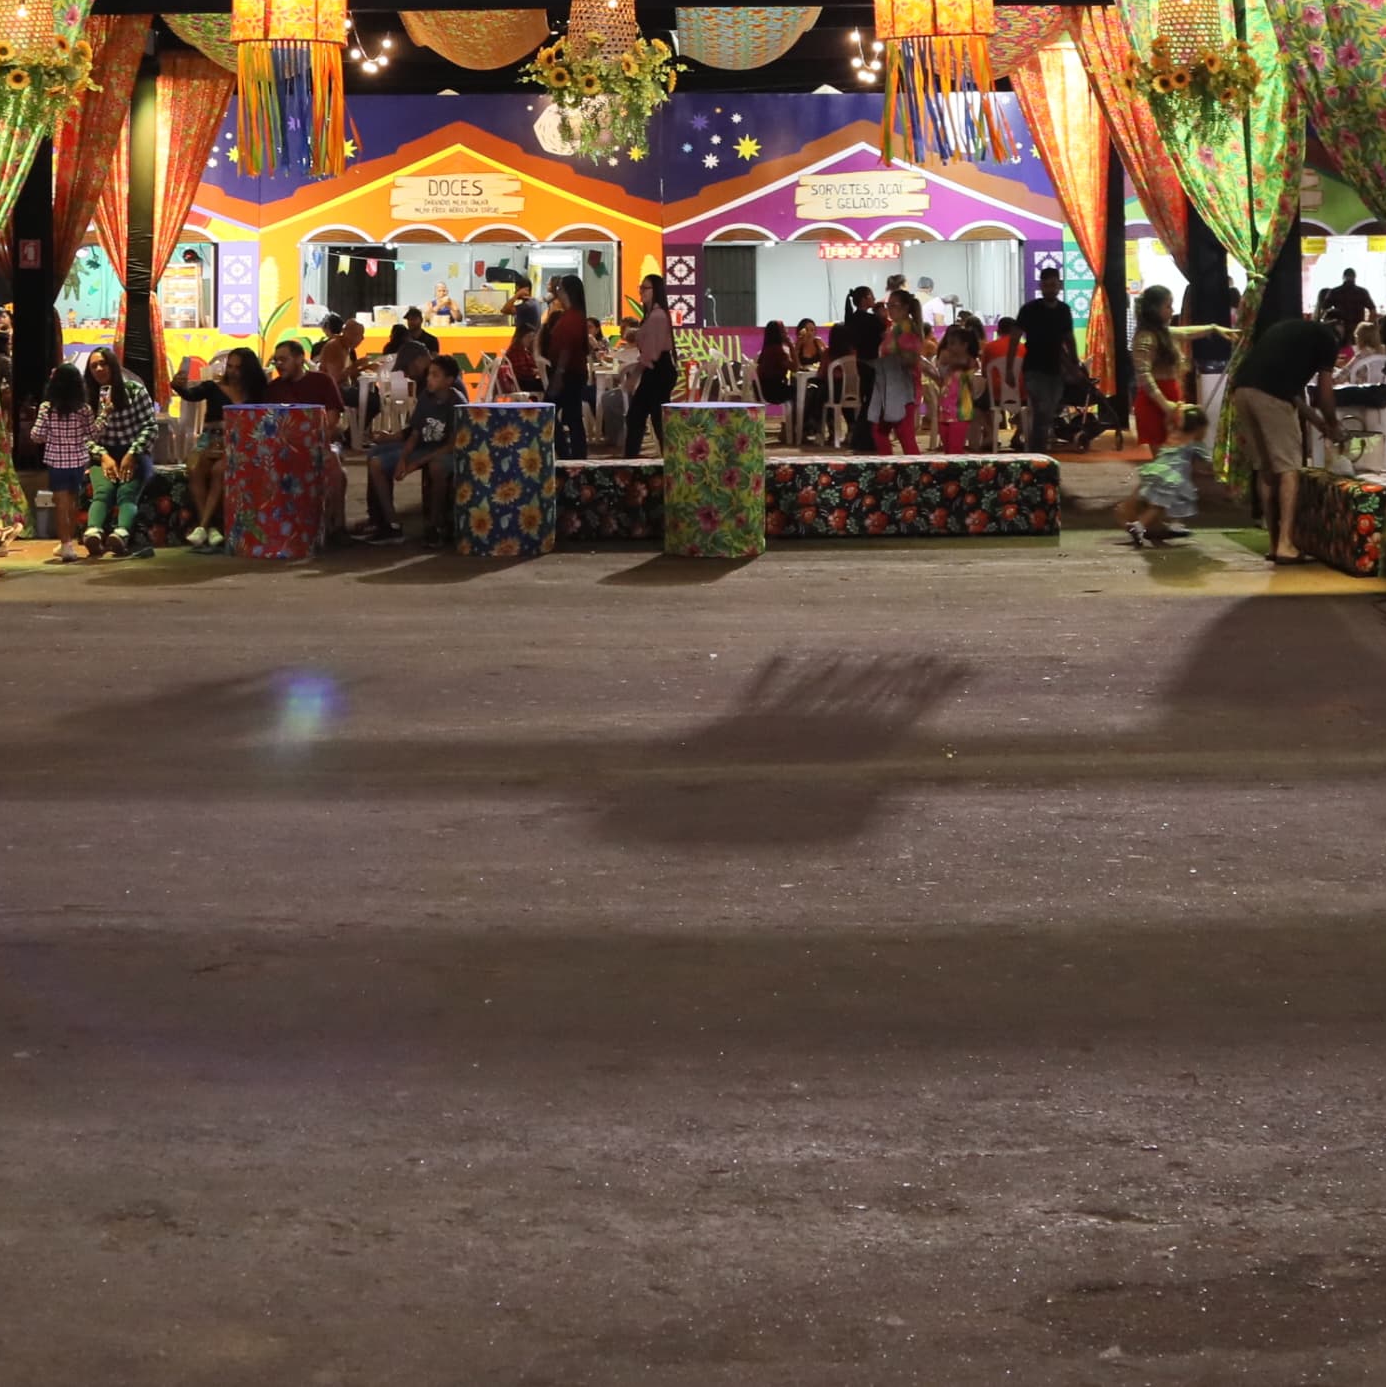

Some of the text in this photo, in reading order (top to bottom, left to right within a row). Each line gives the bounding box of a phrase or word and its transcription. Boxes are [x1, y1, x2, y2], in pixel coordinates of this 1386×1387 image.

[428, 179, 483, 197] DOCES
[811, 183, 873, 197] SORVETES,
[825, 197, 889, 210] E GELADOS
